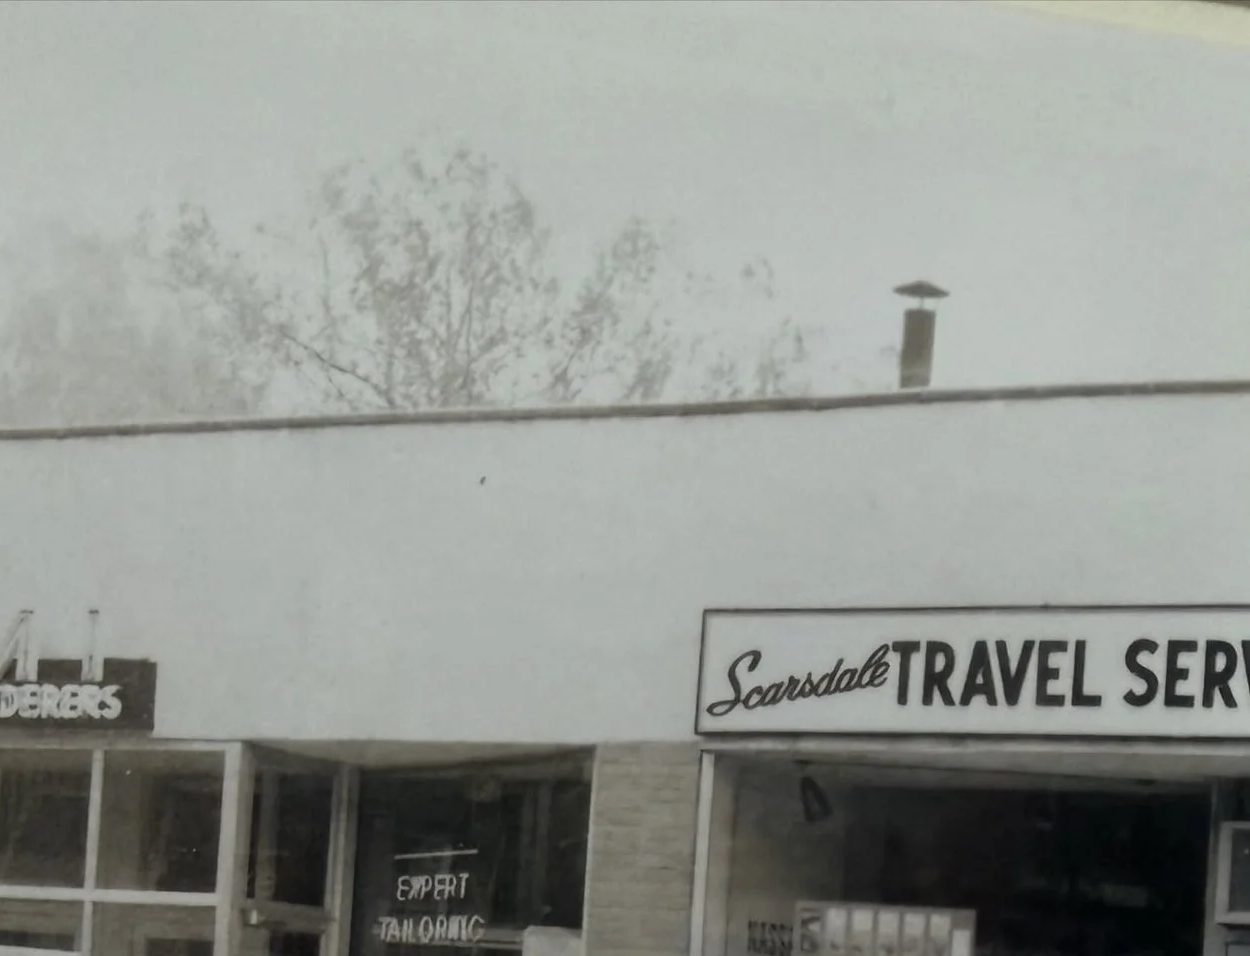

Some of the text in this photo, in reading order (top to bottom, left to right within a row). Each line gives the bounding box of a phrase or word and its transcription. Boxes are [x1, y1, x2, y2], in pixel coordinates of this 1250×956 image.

[706, 642, 891, 718] Scarsdale
[891, 639, 1103, 708] TRAVEL
[396, 872, 470, 901] EXPERT
